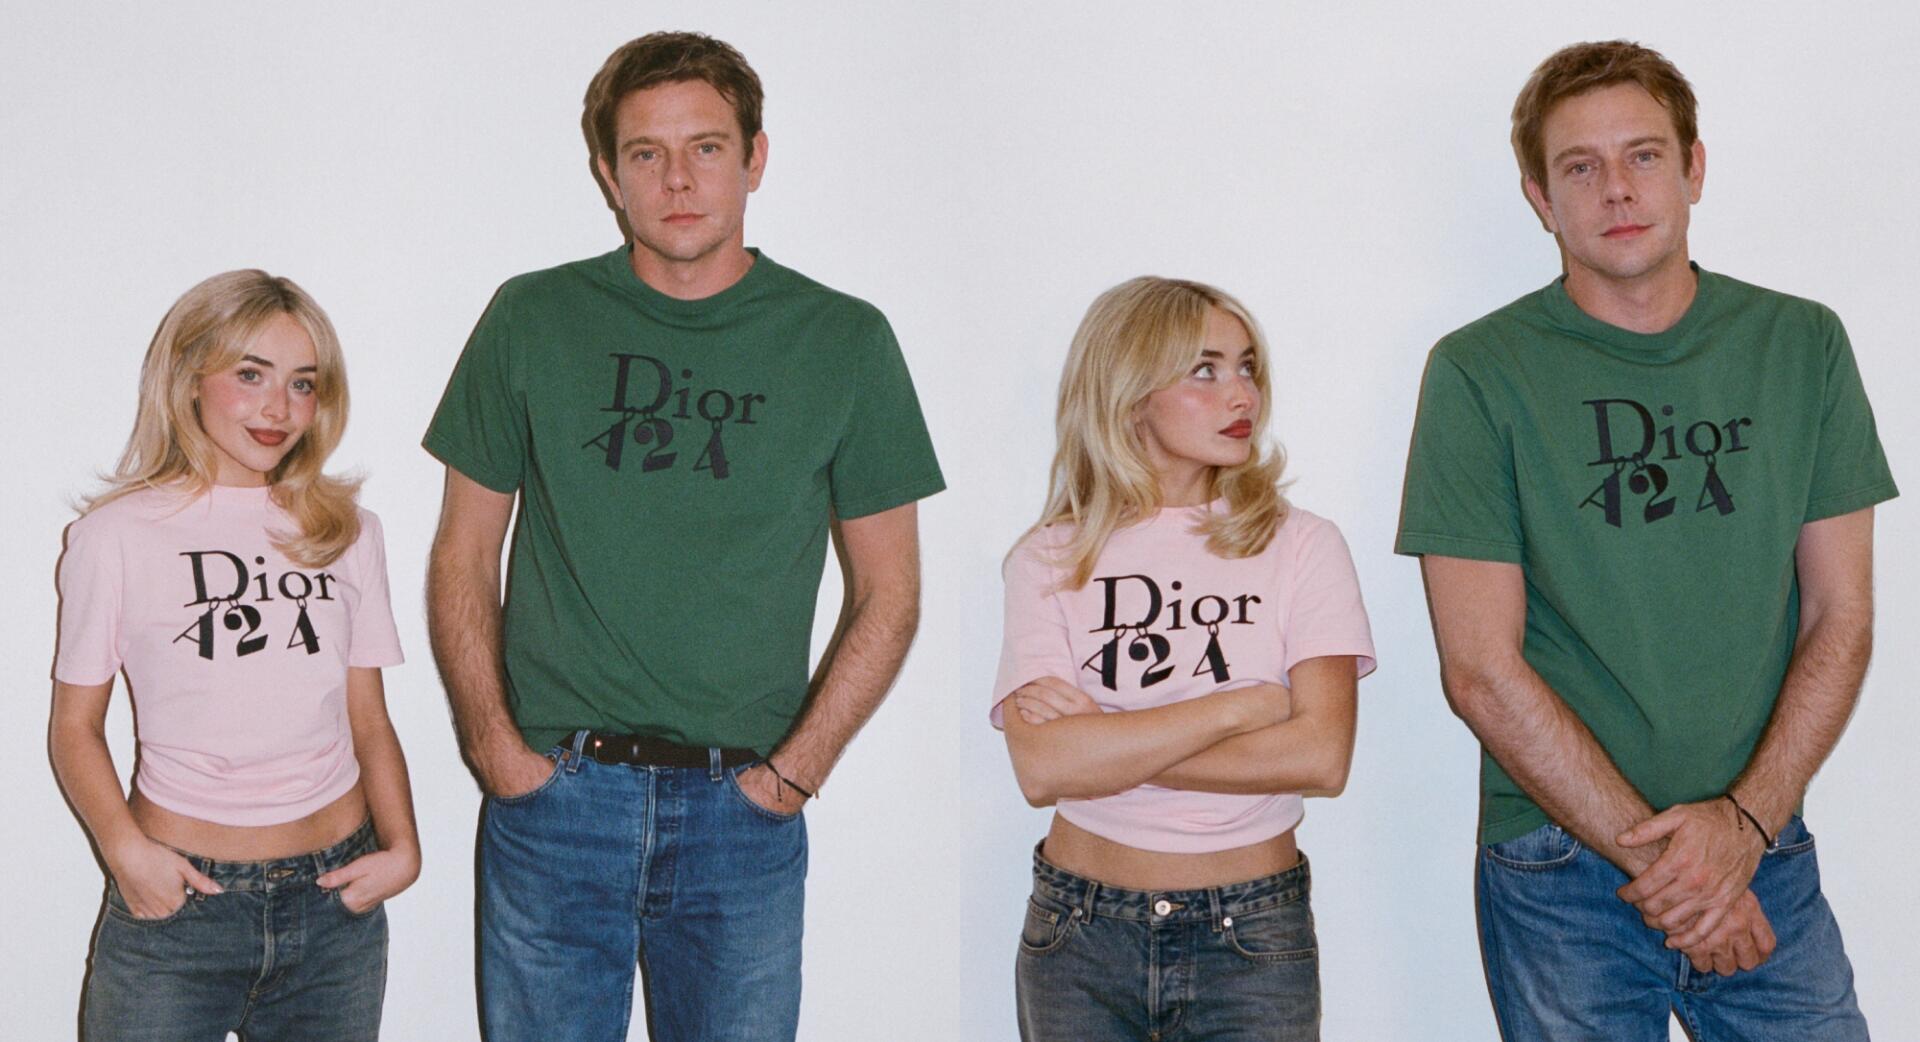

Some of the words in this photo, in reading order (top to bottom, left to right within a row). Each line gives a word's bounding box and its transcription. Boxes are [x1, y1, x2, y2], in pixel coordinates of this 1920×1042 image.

[600, 353, 766, 424] Dior
[1582, 398, 1752, 466] Dior
[179, 550, 336, 608] Dior
[1088, 574, 1262, 633] Dior
